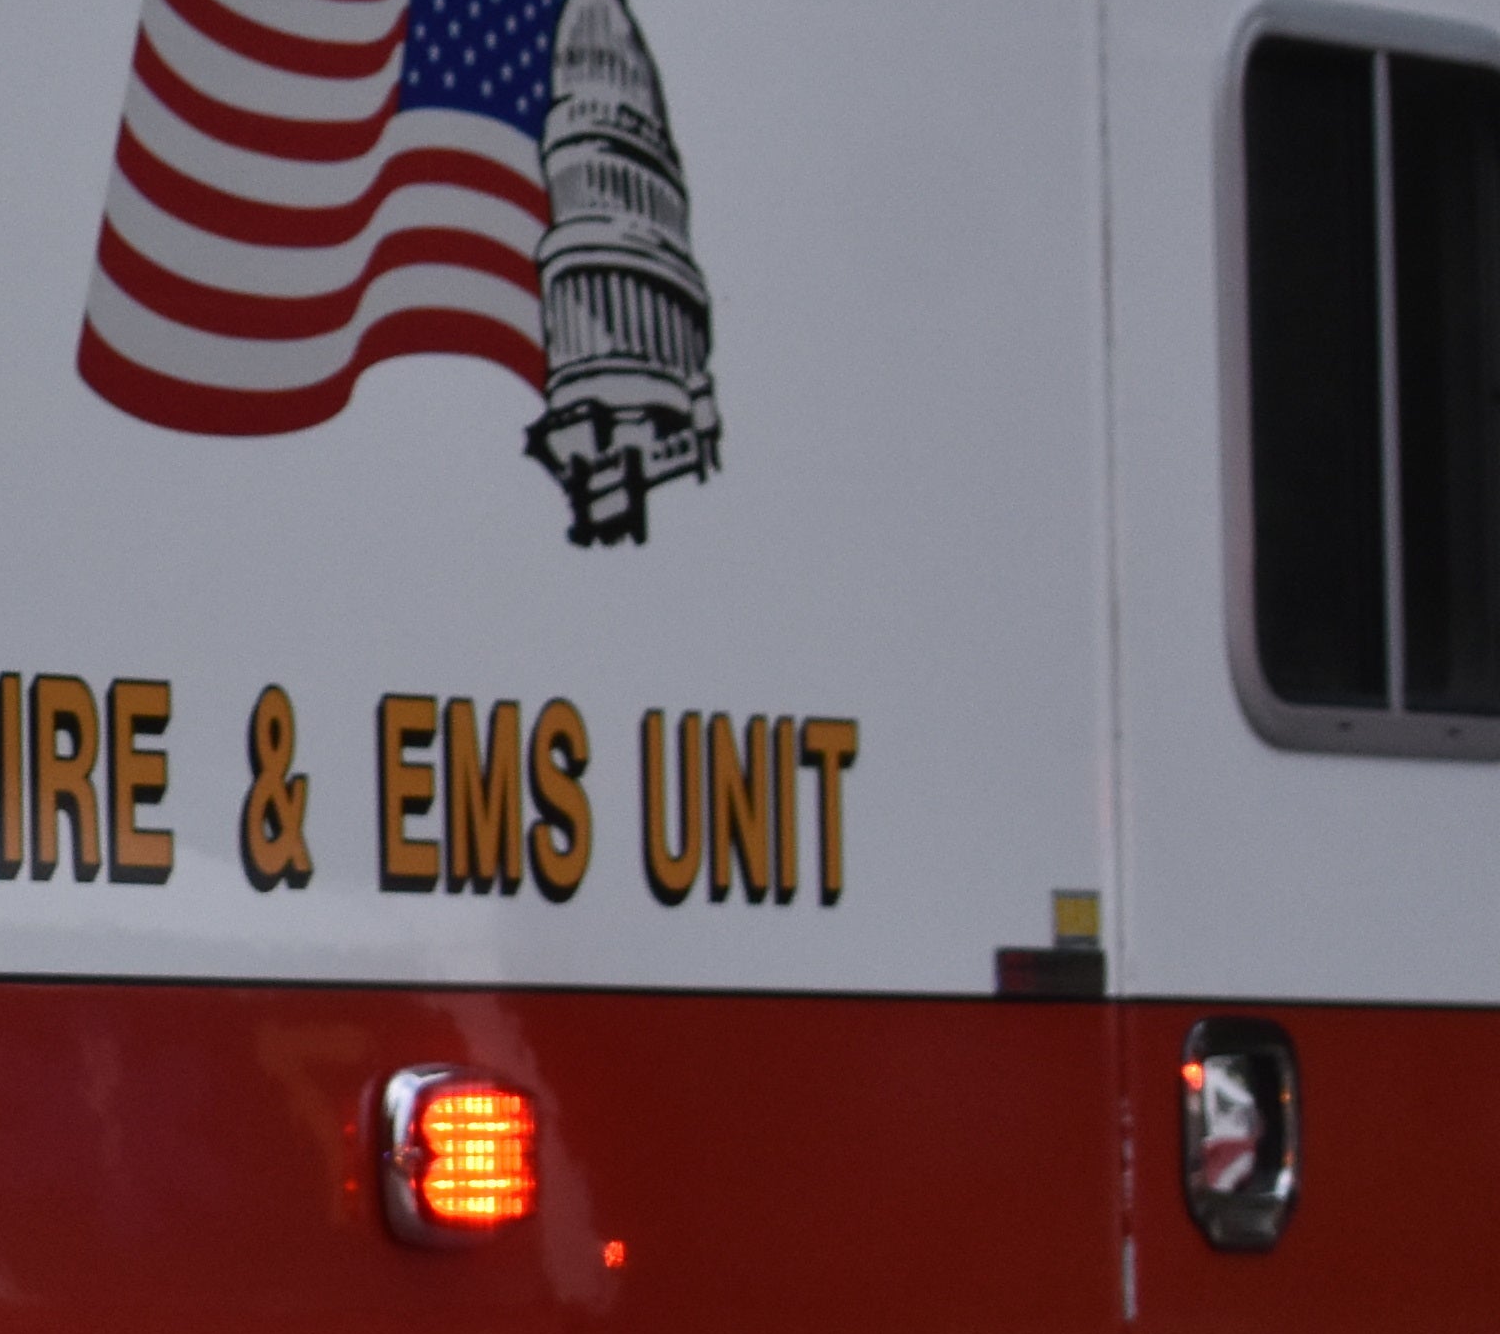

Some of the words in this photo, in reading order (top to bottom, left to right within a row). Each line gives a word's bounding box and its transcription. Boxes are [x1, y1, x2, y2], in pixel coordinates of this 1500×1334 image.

[239, 683, 313, 893] &
[376, 692, 592, 904] EMS
[640, 707, 858, 907] UNIT
